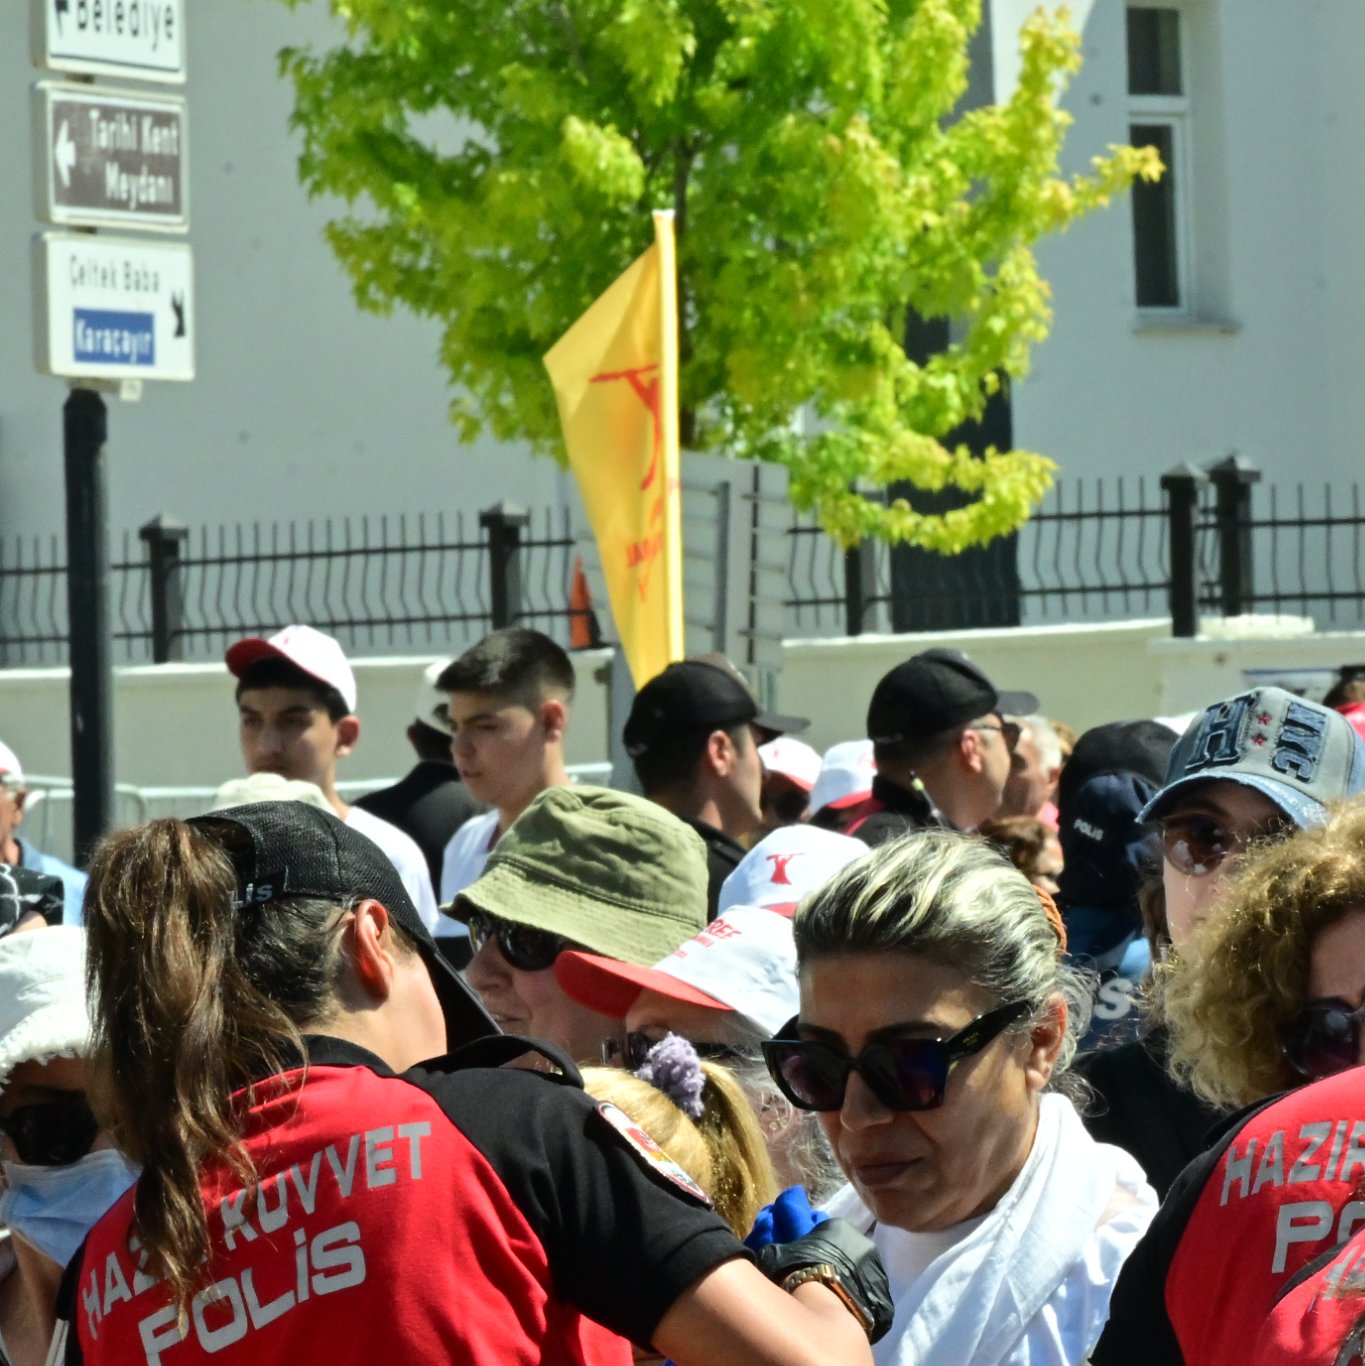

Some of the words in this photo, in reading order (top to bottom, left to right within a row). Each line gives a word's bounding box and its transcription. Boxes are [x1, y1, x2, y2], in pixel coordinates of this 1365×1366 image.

[141, 115, 178, 156] Kent
[123, 260, 160, 293] Baba
[1270, 700, 1328, 783] NYC
[220, 1121, 432, 1251] KUVVET
